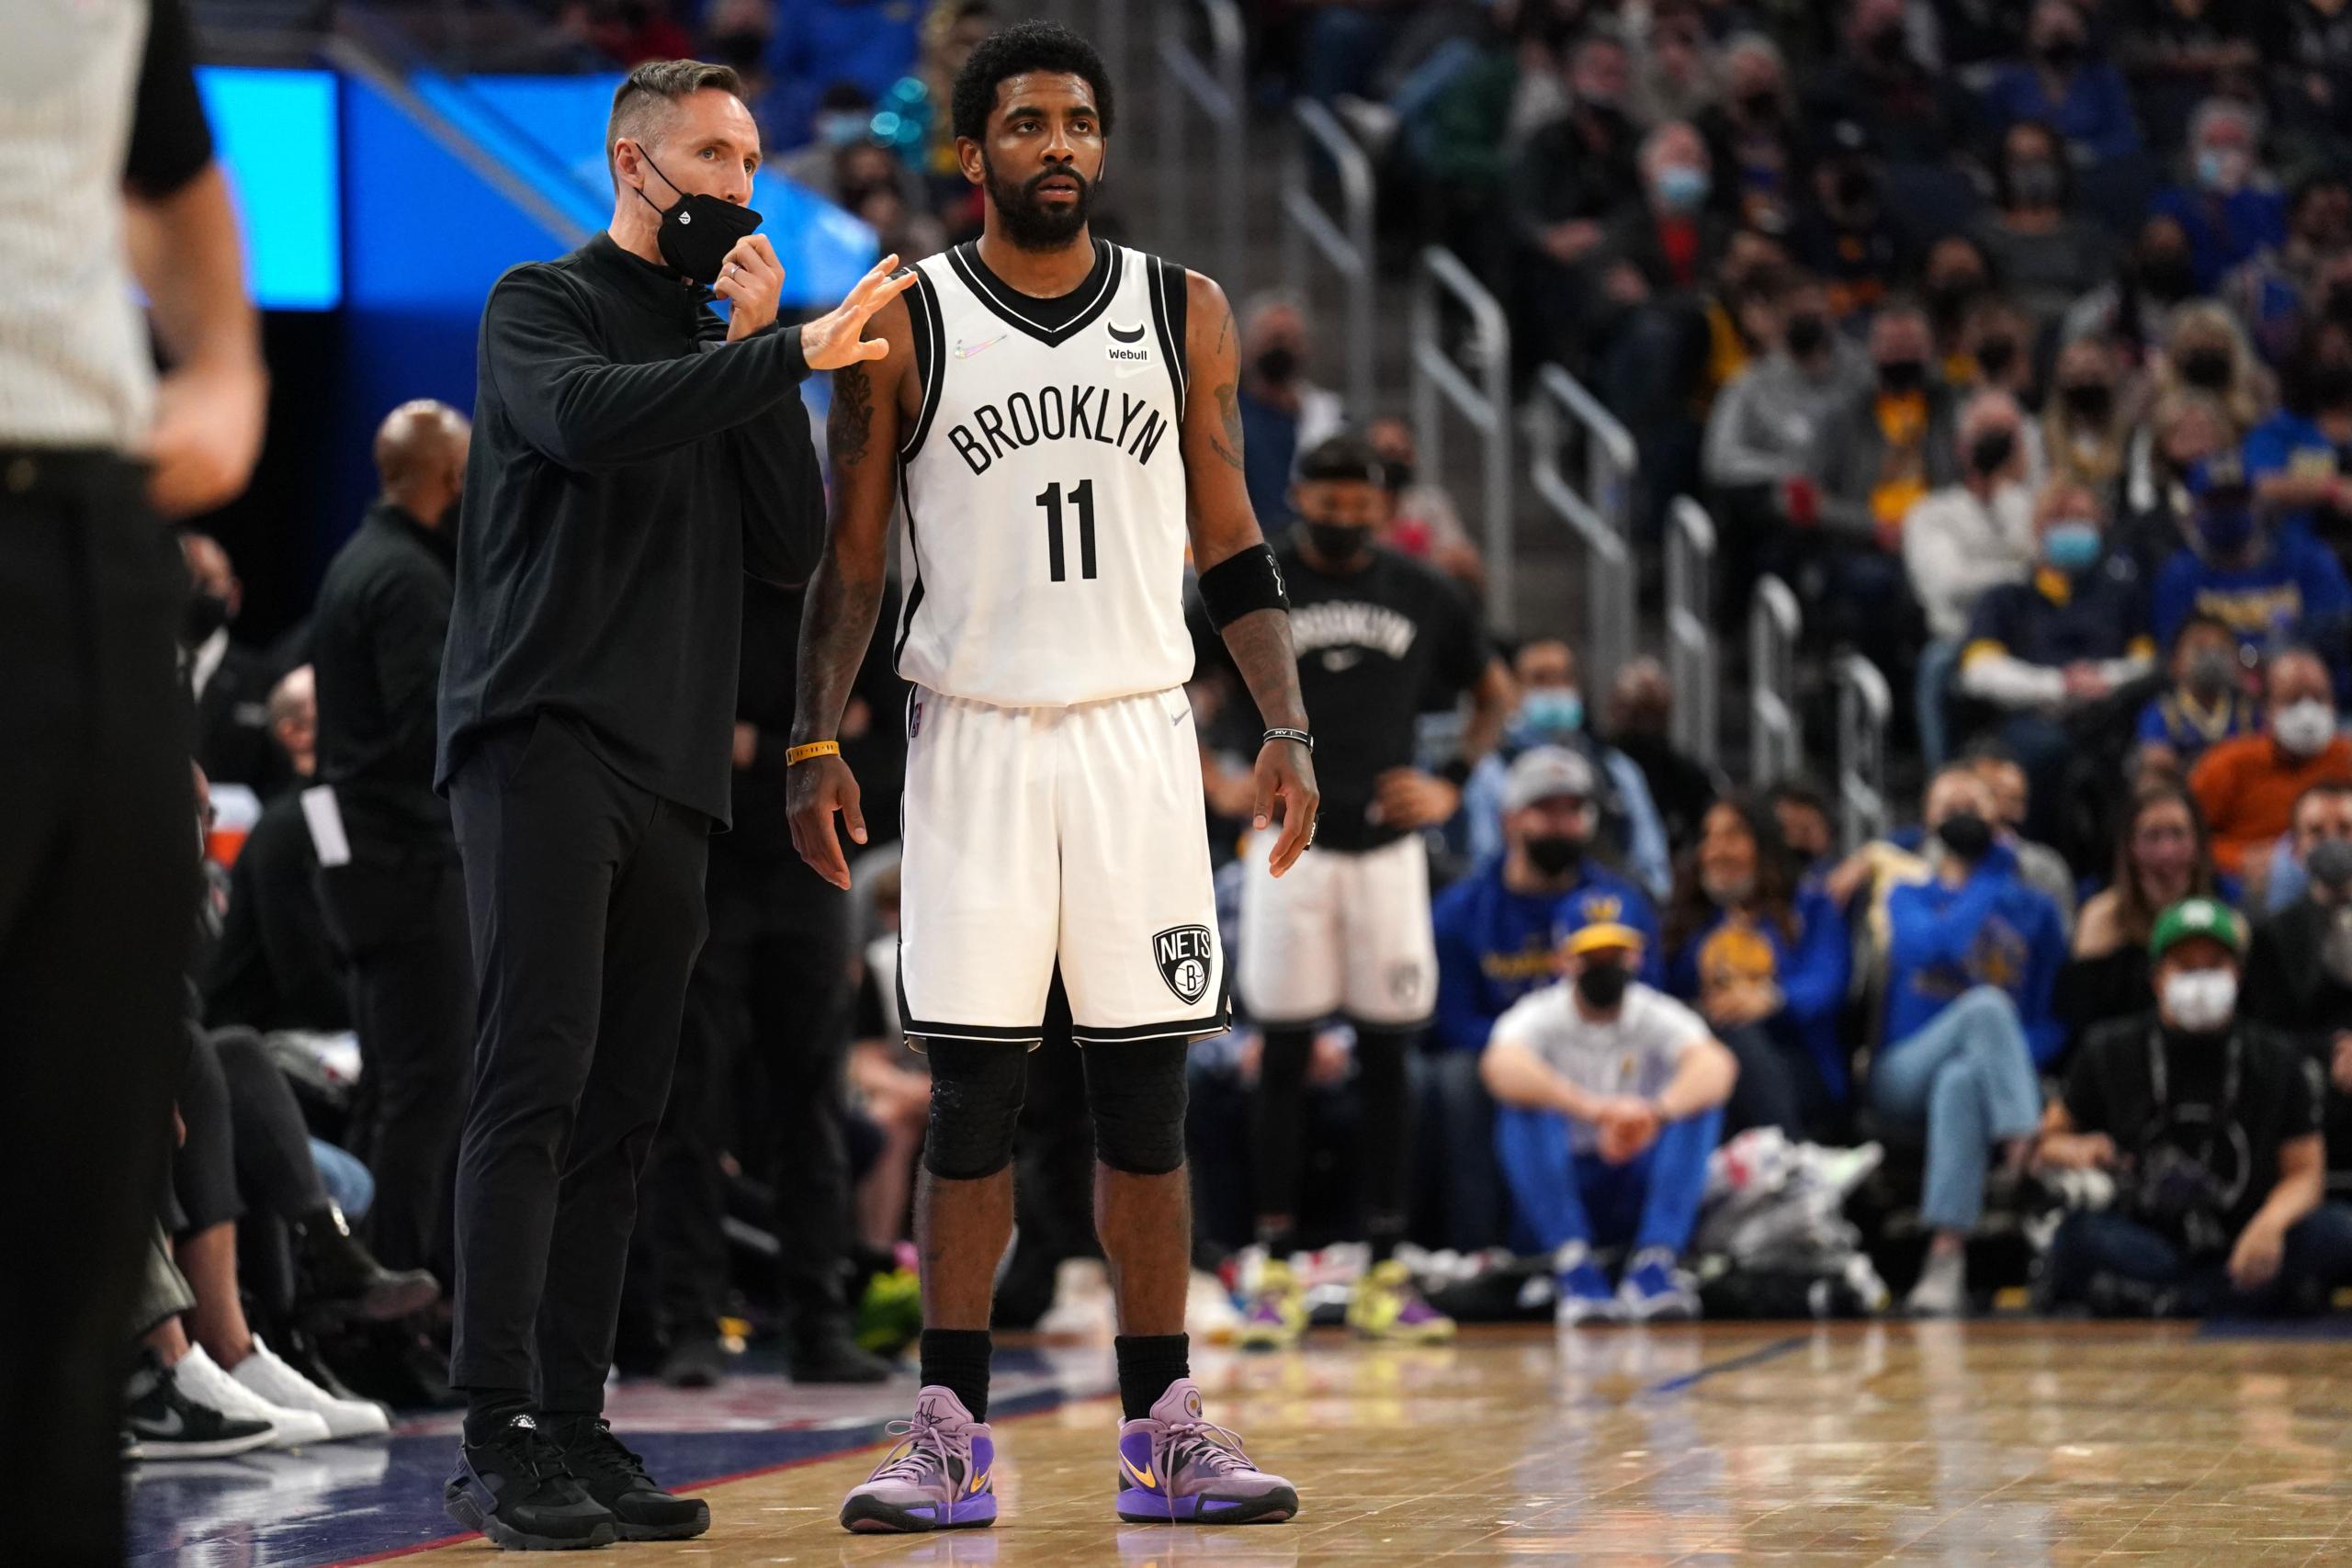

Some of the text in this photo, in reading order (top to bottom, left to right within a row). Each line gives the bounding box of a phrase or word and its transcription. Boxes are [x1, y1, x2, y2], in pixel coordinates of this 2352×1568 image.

[1109, 349, 1147, 360] Webull
[948, 385, 1168, 476] BROOKLYN
[1035, 479, 1097, 582] 11
[1160, 931, 1211, 964] NETS
[1186, 964, 1196, 991] B
